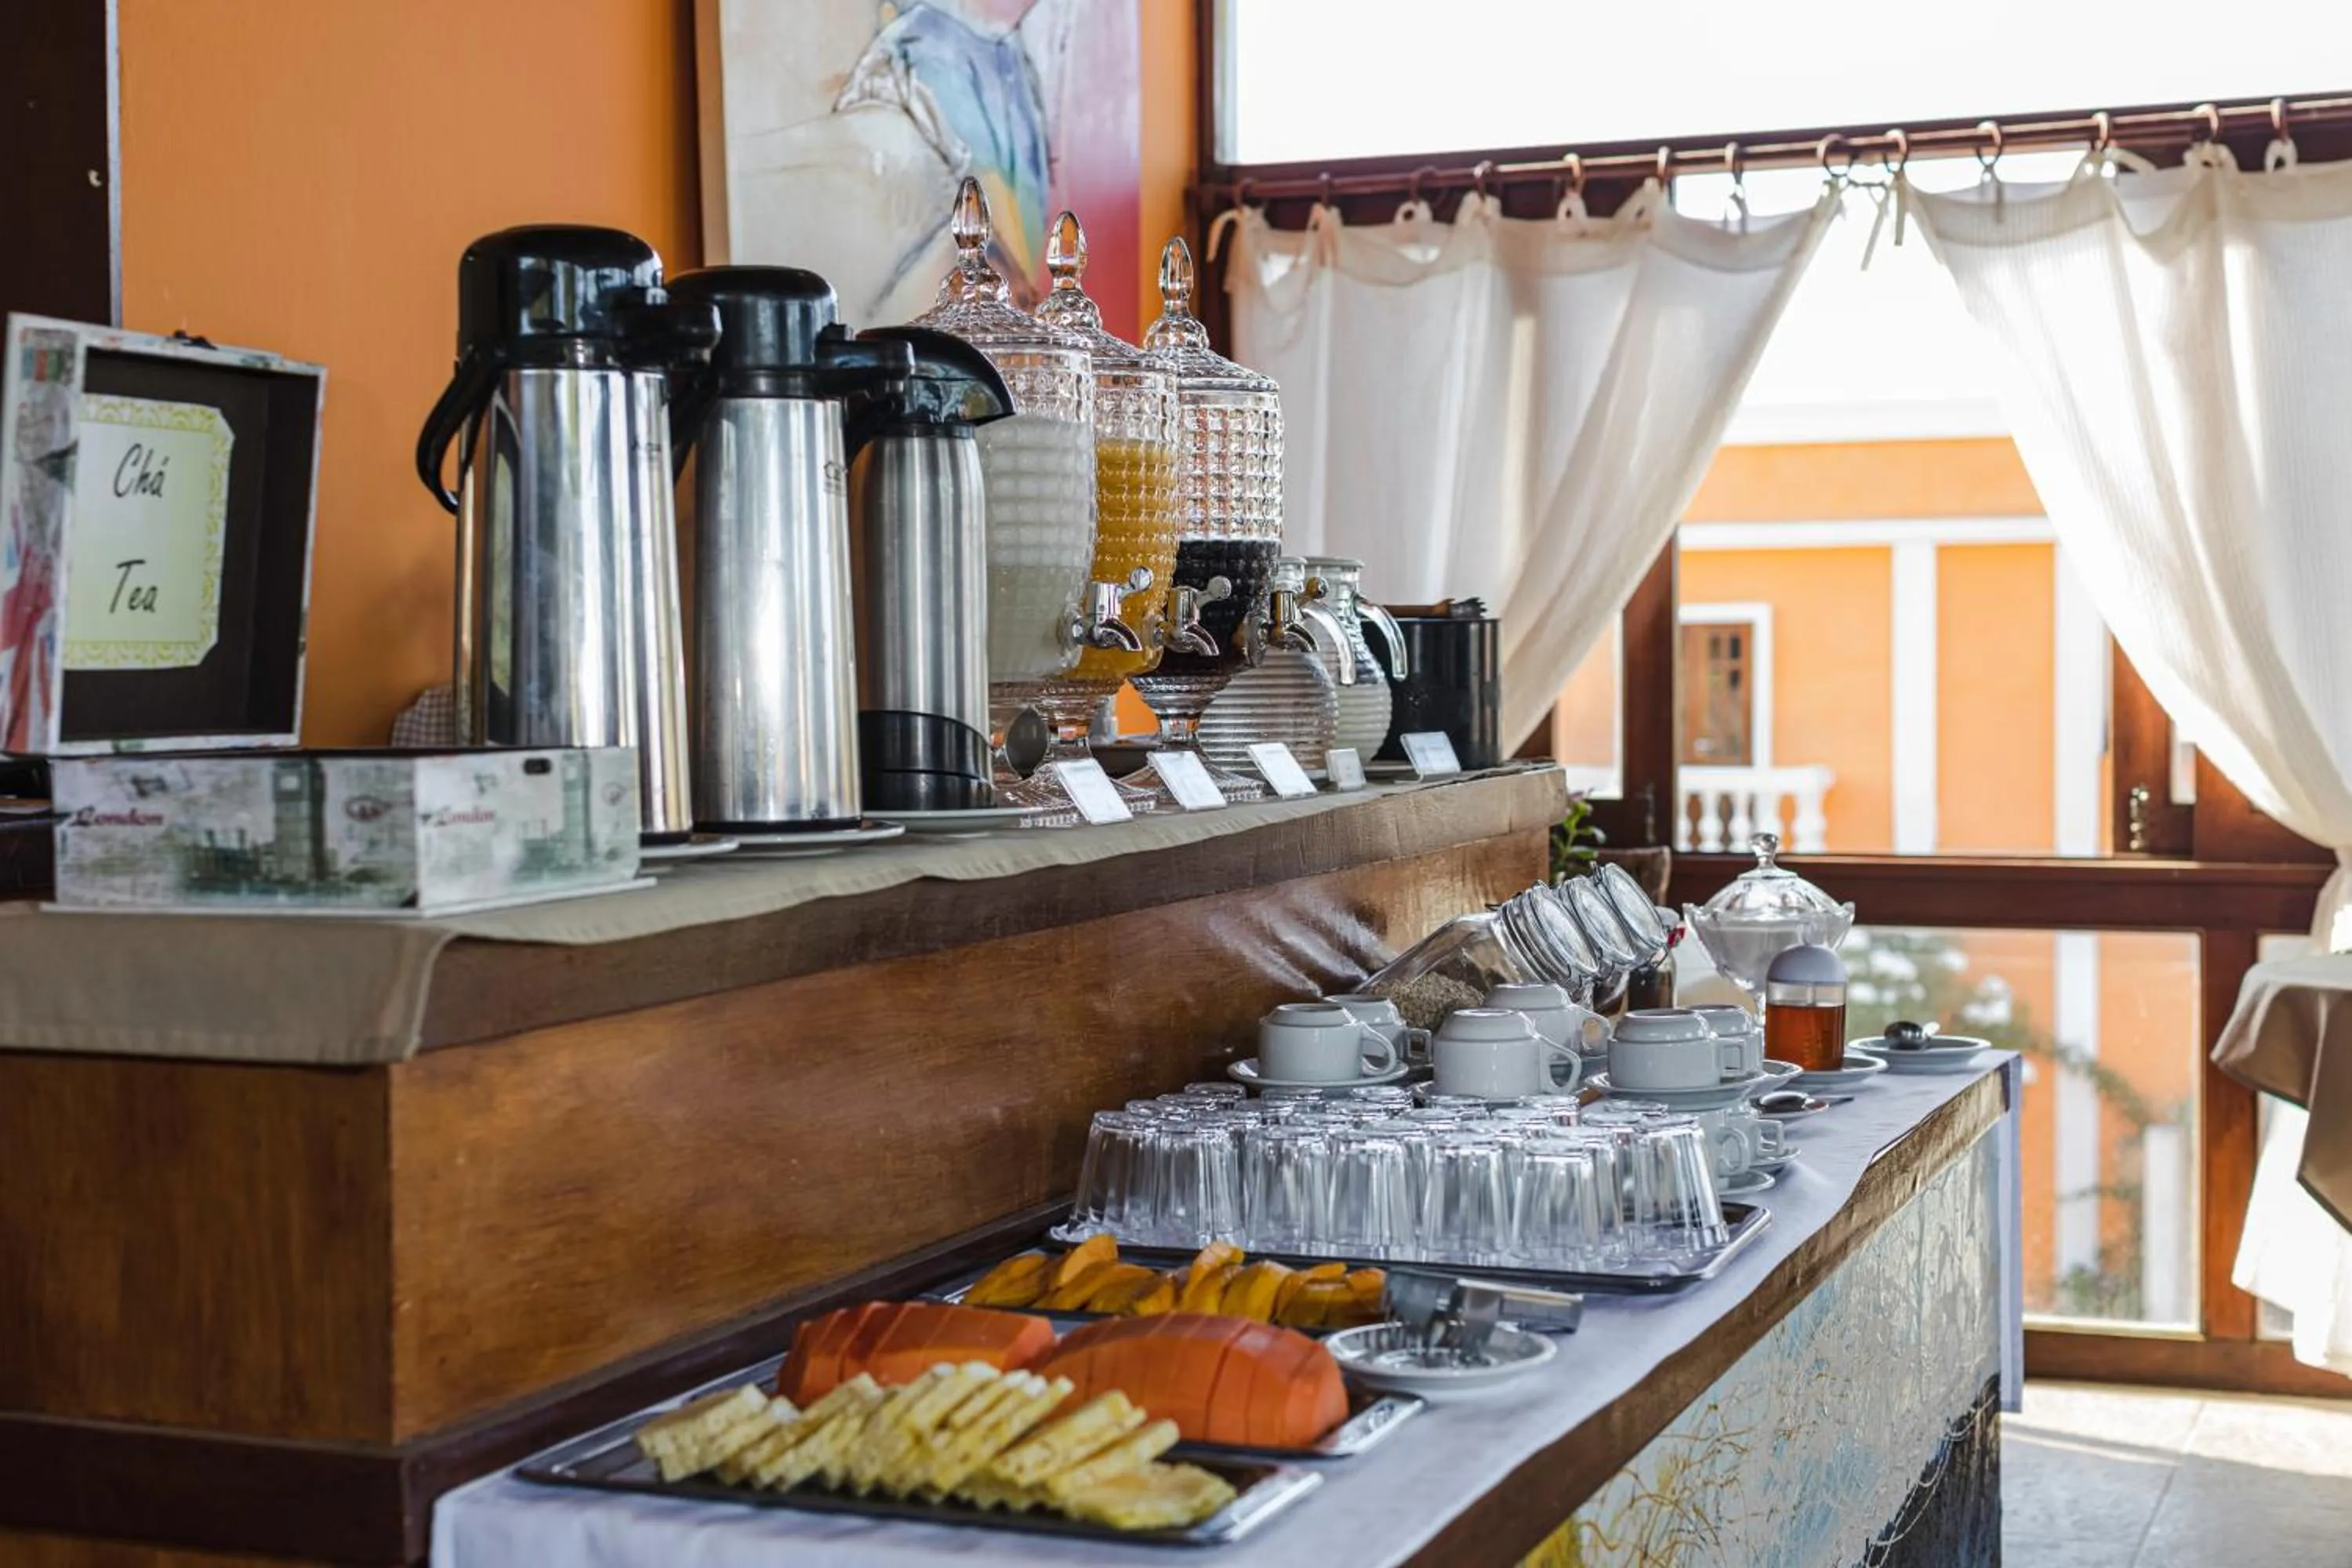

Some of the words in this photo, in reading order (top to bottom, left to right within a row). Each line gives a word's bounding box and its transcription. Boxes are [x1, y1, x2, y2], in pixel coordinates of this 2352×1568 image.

[113, 444, 169, 498] Chá
[110, 560, 158, 613] Tea
[69, 805, 164, 826] London
